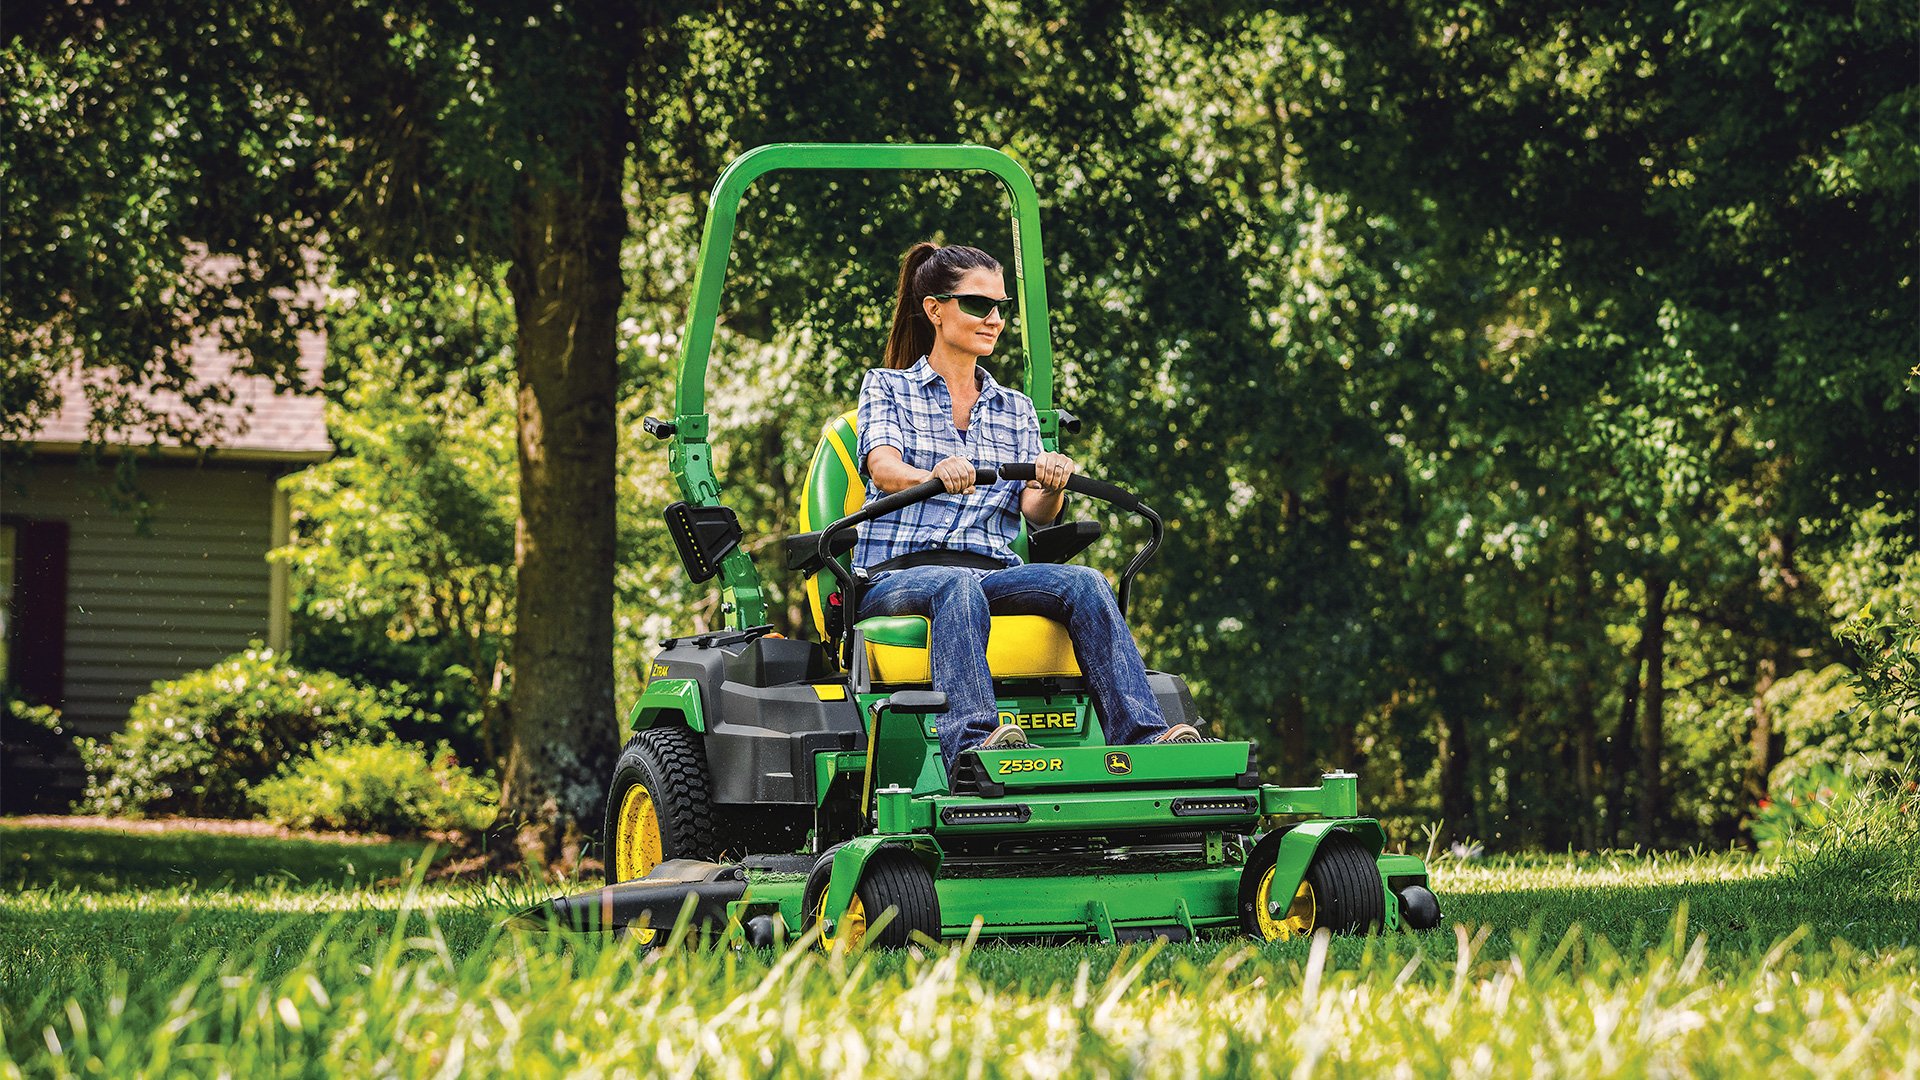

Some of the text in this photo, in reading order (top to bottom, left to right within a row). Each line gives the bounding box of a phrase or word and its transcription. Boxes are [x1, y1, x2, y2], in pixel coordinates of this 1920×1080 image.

[998, 711, 1077, 730] DEERE
[998, 758, 1063, 775] Z530 R
